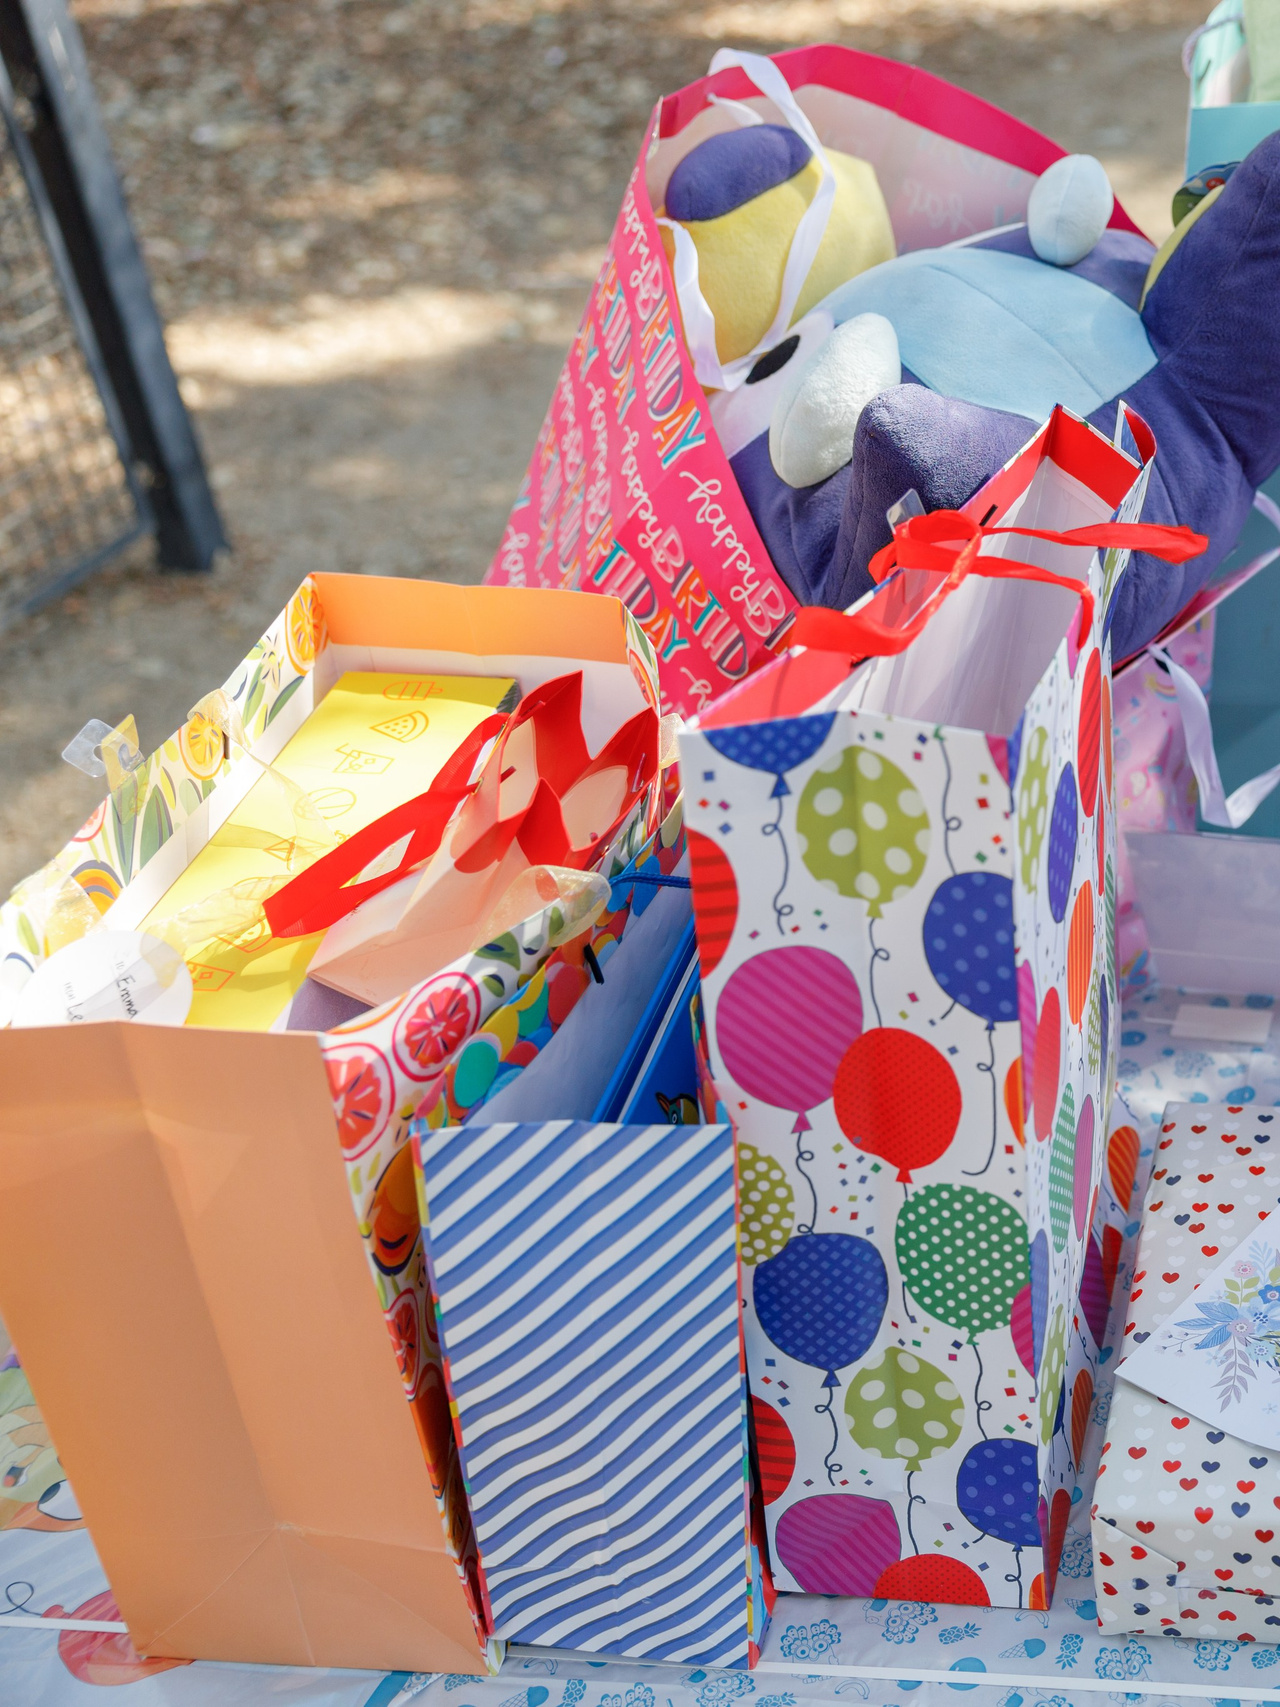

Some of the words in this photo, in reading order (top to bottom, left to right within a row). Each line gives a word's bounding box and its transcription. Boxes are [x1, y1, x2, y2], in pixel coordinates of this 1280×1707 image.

[621, 425, 668, 564] happy
[651, 525, 750, 681] BIRTHD
[635, 255, 706, 470] BIRTHDAY
[679, 471, 761, 617] happy
[116, 974, 139, 1019] Emma
